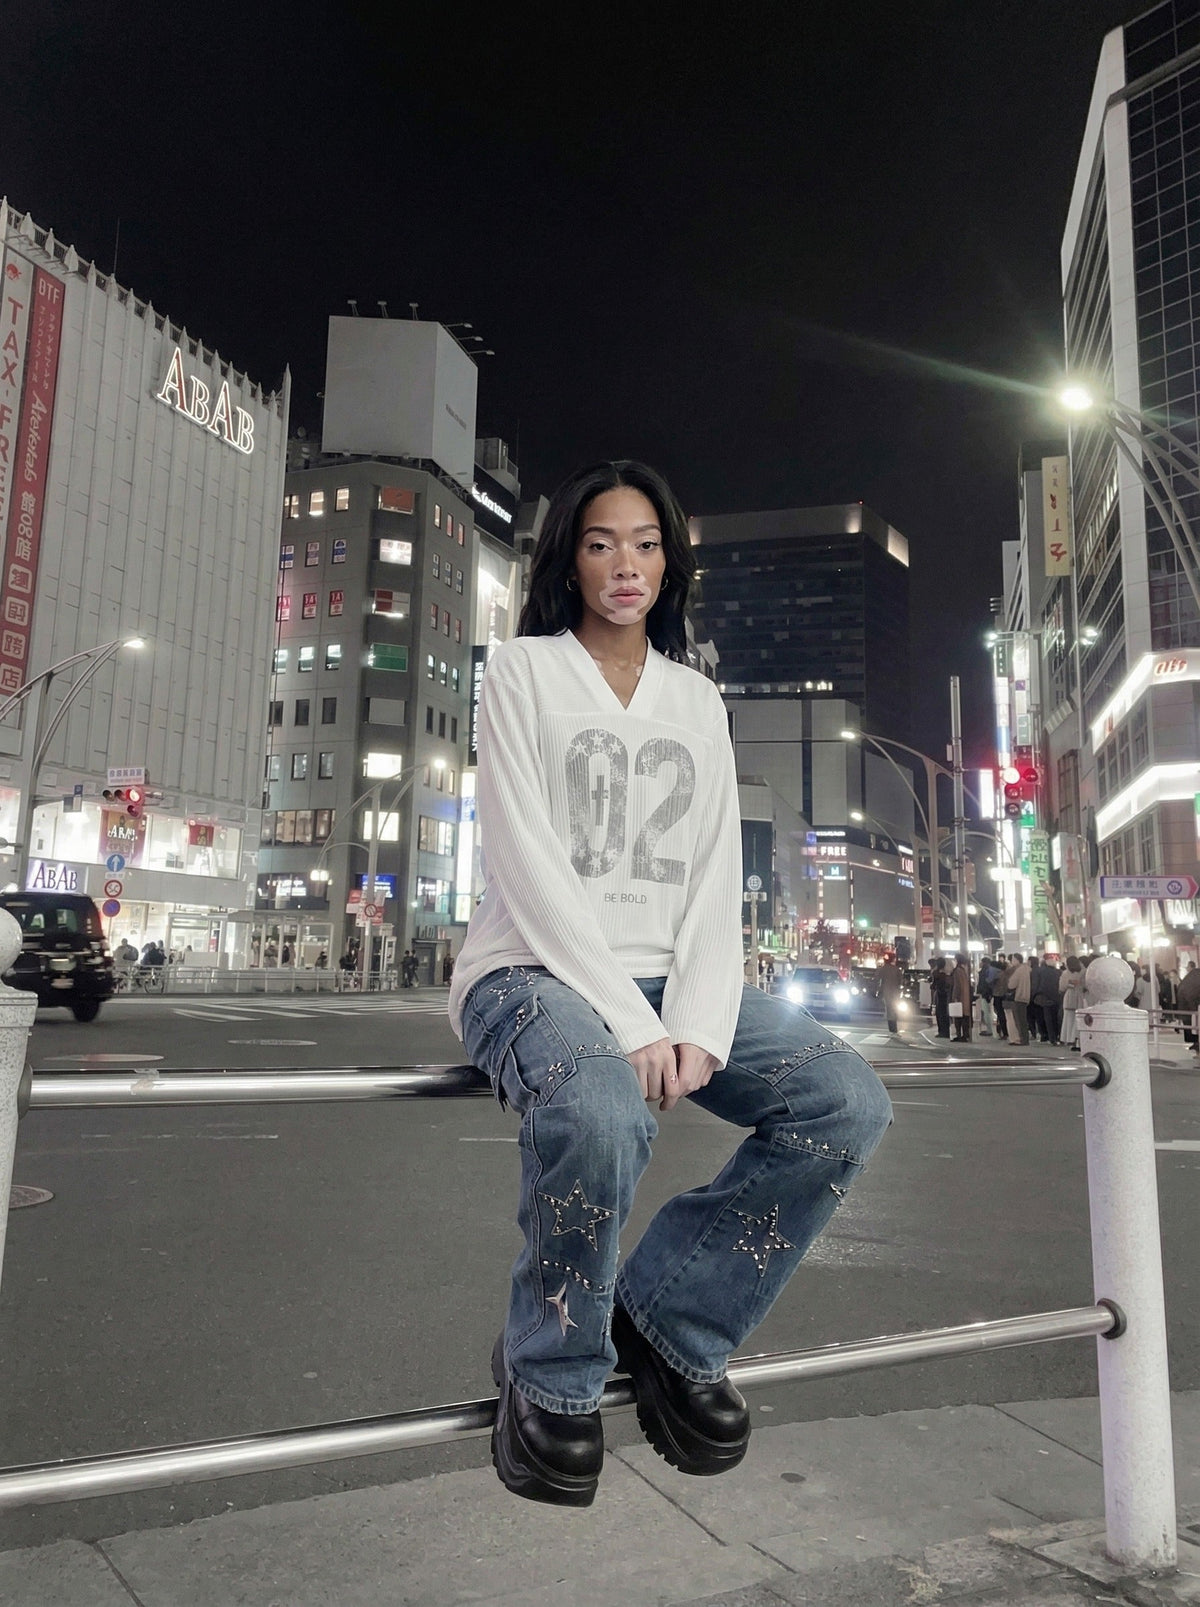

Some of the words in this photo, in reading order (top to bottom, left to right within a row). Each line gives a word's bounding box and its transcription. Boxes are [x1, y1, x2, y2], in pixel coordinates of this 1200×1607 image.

[564, 728, 696, 886] 02
[32, 862, 78, 891] ABAB
[604, 892, 617, 903] BE
[620, 893, 647, 905] BOLD
